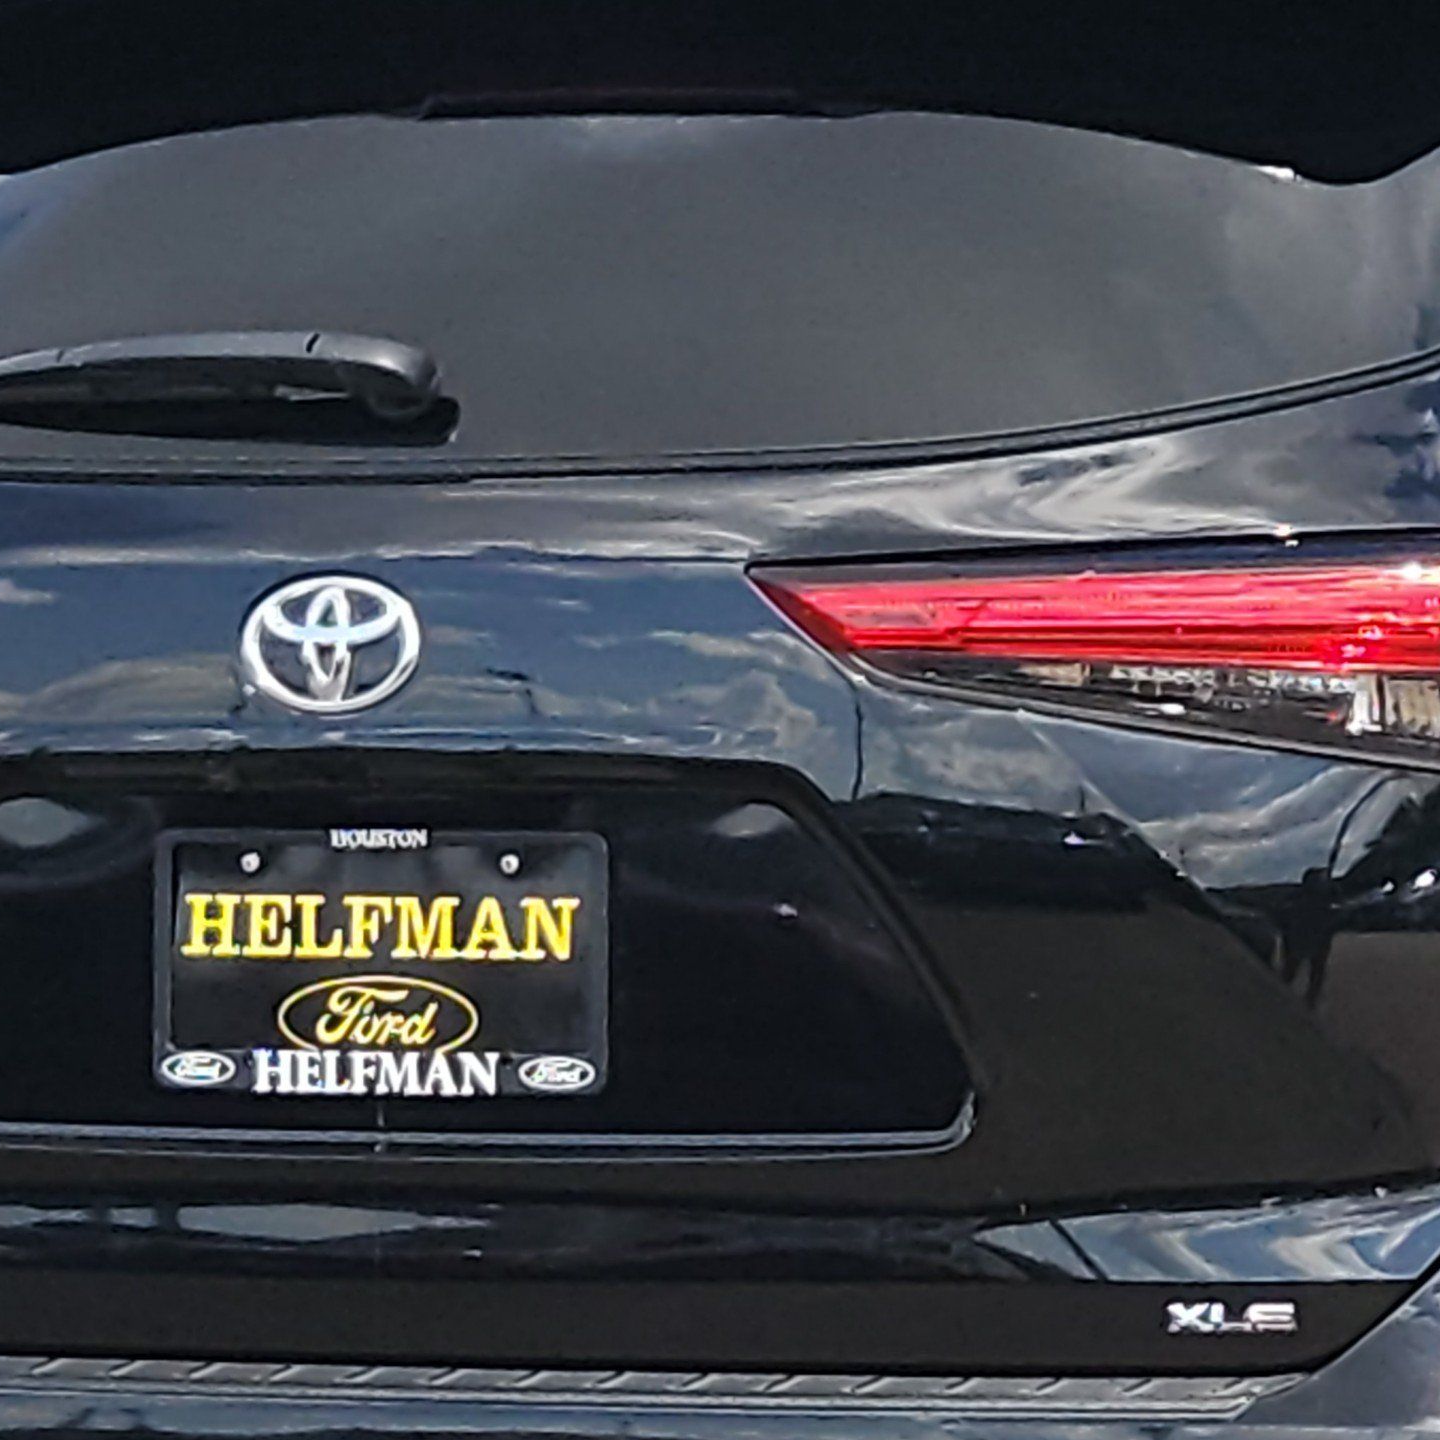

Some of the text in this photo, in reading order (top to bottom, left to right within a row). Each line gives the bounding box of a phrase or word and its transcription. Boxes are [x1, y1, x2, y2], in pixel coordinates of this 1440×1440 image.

[329, 828, 429, 850] HOUSTON
[180, 893, 581, 961] HELFMAN
[314, 985, 440, 1046] Ford
[252, 1048, 501, 1098] HELFMAN
